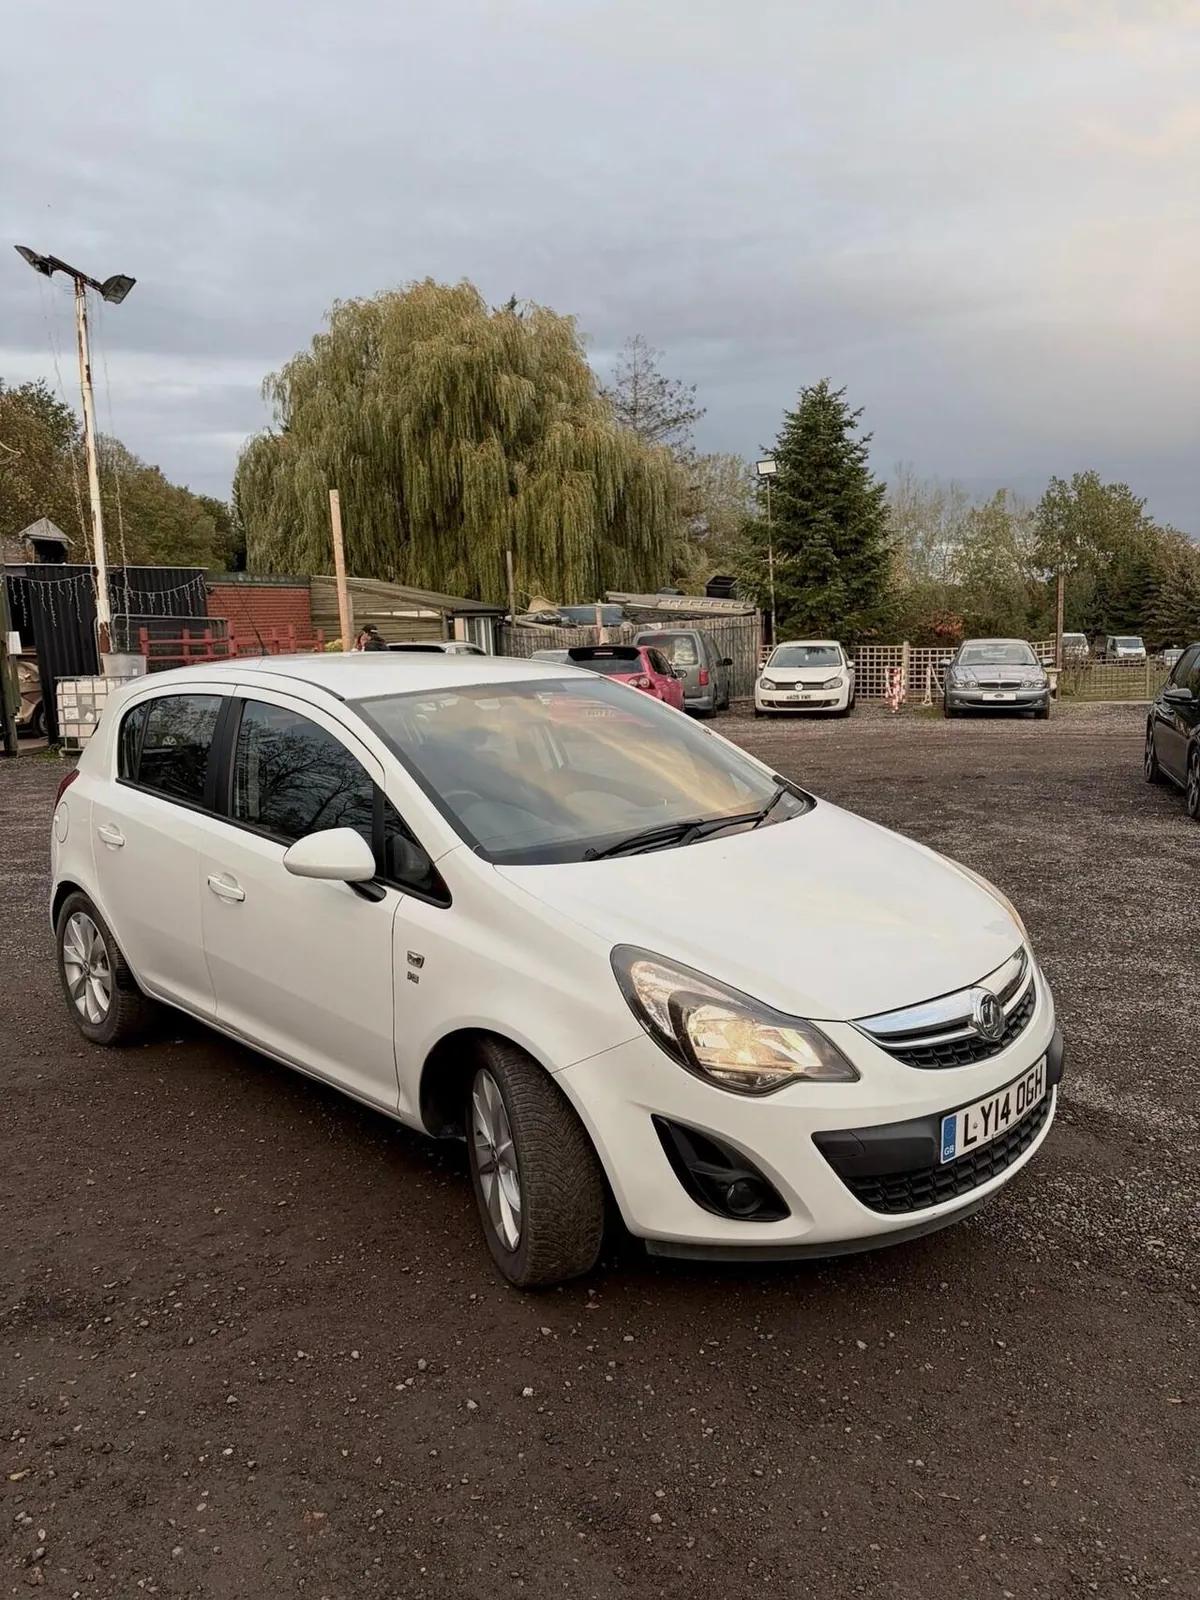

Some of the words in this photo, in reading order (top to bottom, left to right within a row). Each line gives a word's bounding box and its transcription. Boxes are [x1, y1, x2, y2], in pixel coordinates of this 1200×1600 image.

[963, 1092, 1011, 1148] LY14
[1016, 1063, 1043, 1116] OGH
[944, 1144, 955, 1156] GB
